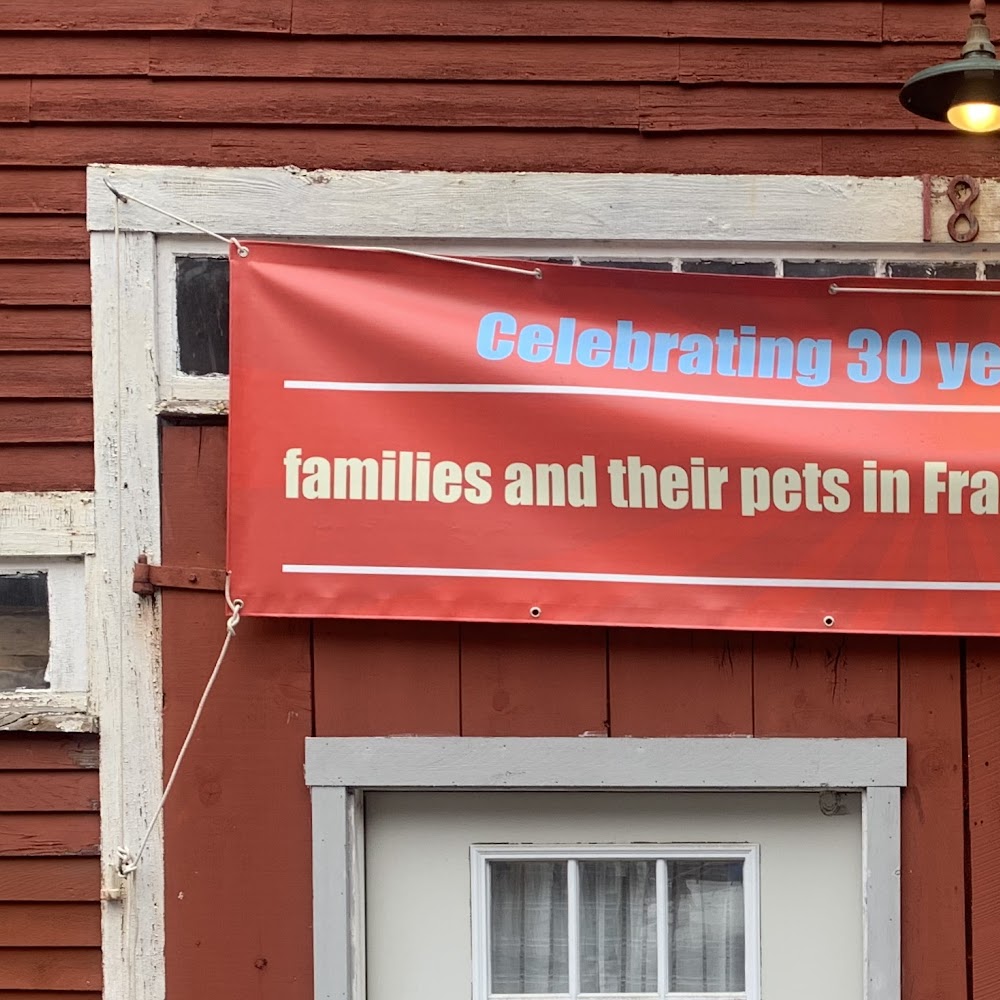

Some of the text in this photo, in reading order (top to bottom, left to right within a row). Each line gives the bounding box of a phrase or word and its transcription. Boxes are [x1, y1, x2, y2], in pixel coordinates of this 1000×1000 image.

[475, 311, 832, 388] Celebrating
[846, 328, 923, 386] 30
[282, 447, 493, 505] families
[503, 454, 598, 509] and
[607, 456, 729, 511] their
[740, 463, 851, 516] pets
[862, 459, 912, 515] in
